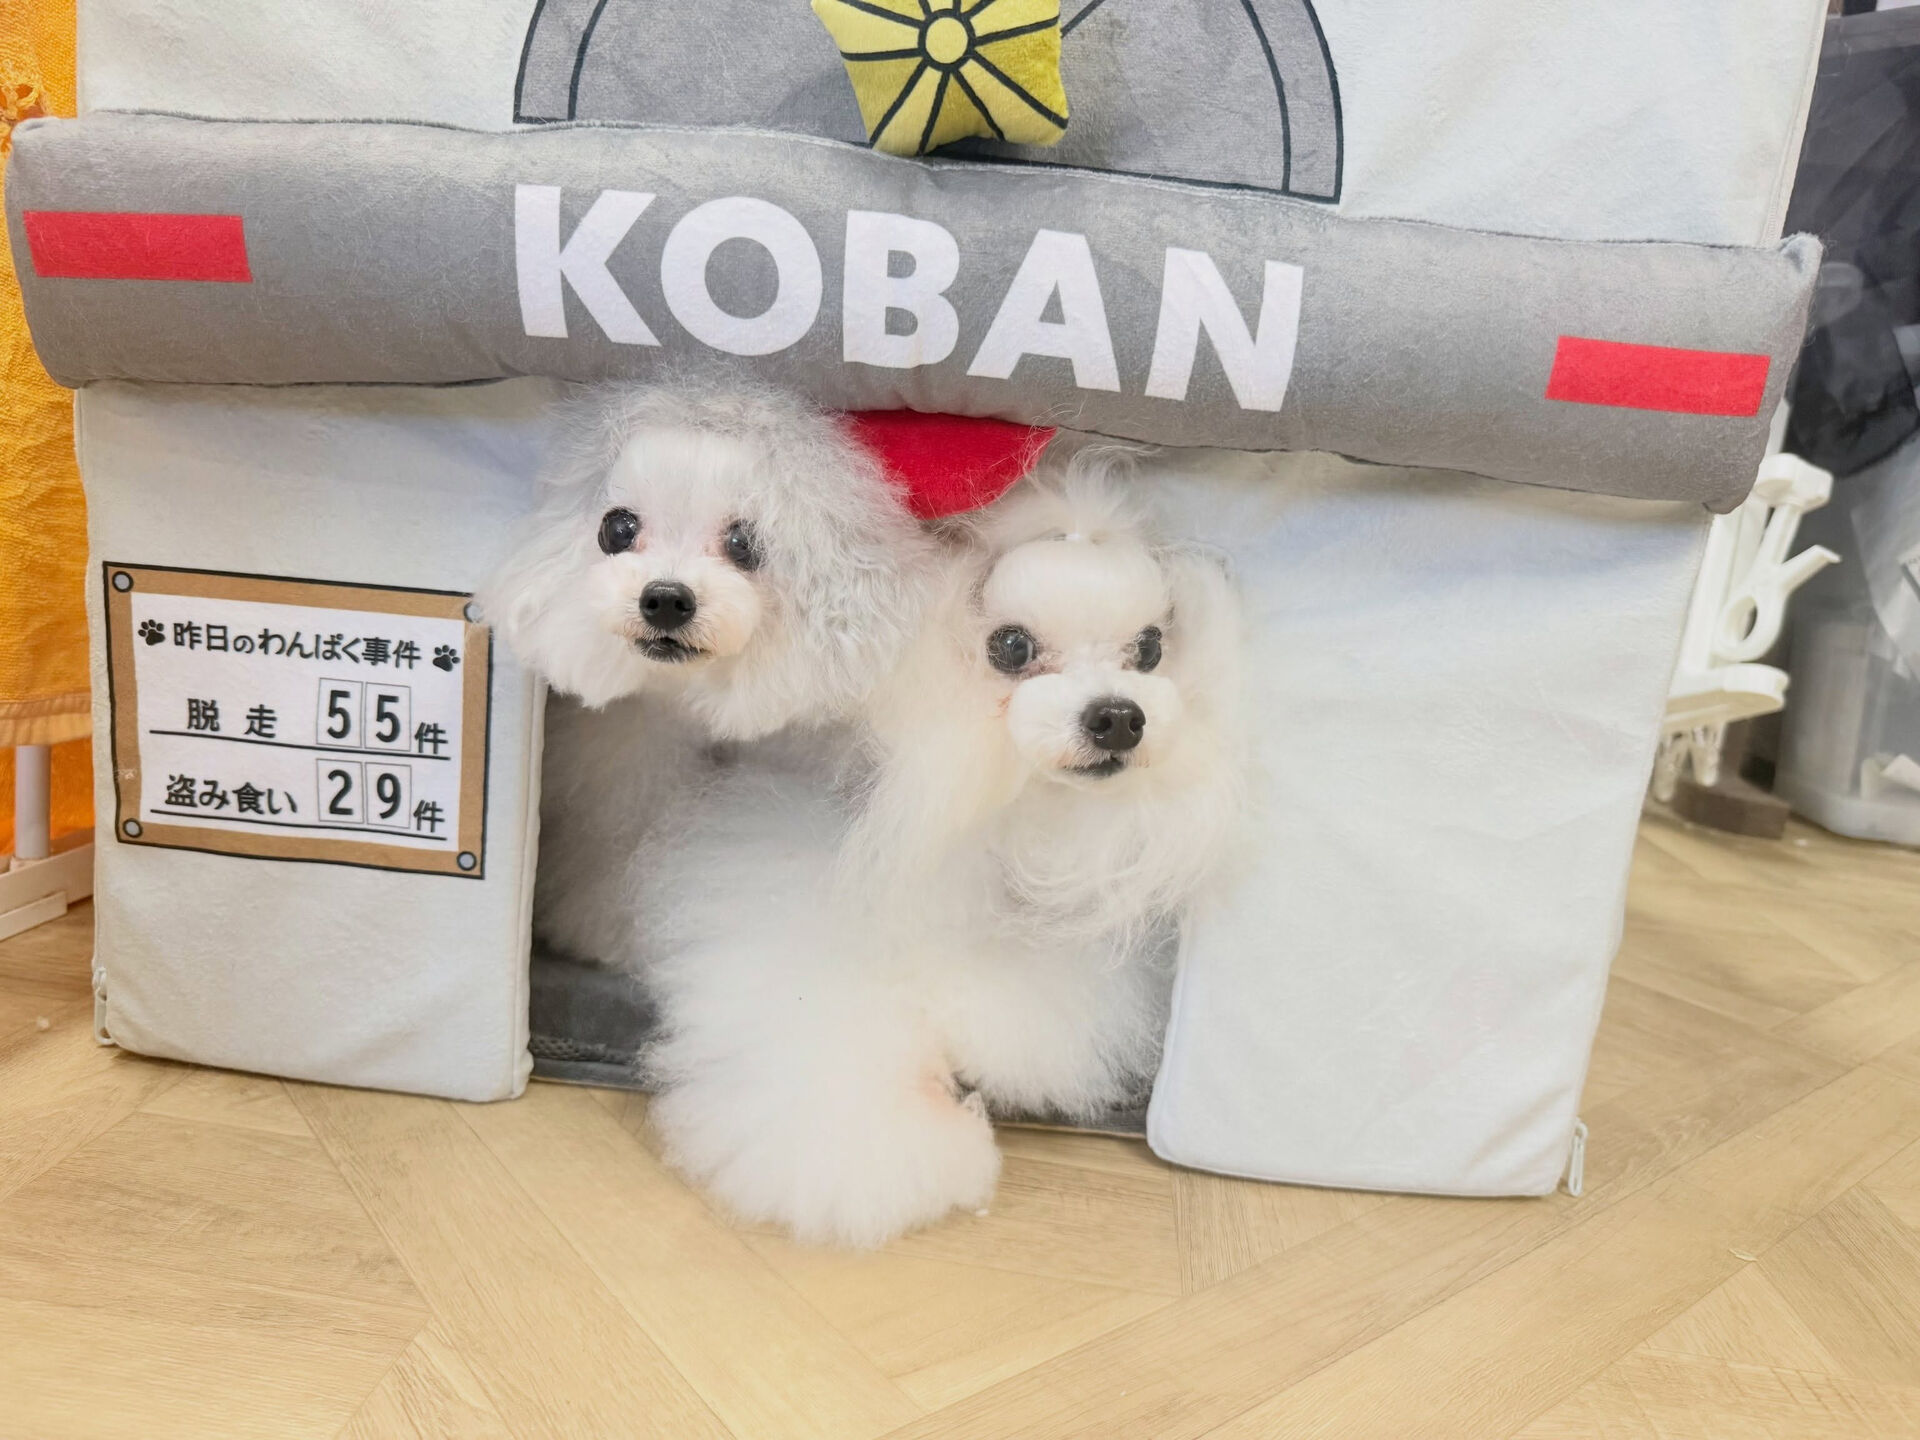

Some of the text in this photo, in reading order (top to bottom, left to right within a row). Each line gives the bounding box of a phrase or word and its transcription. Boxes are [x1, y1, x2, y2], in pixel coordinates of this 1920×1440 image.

[514, 184, 1305, 413] KOBAN
[172, 620, 422, 669] 昨日のわんぱく事件
[164, 773, 298, 815] 盗み食い
